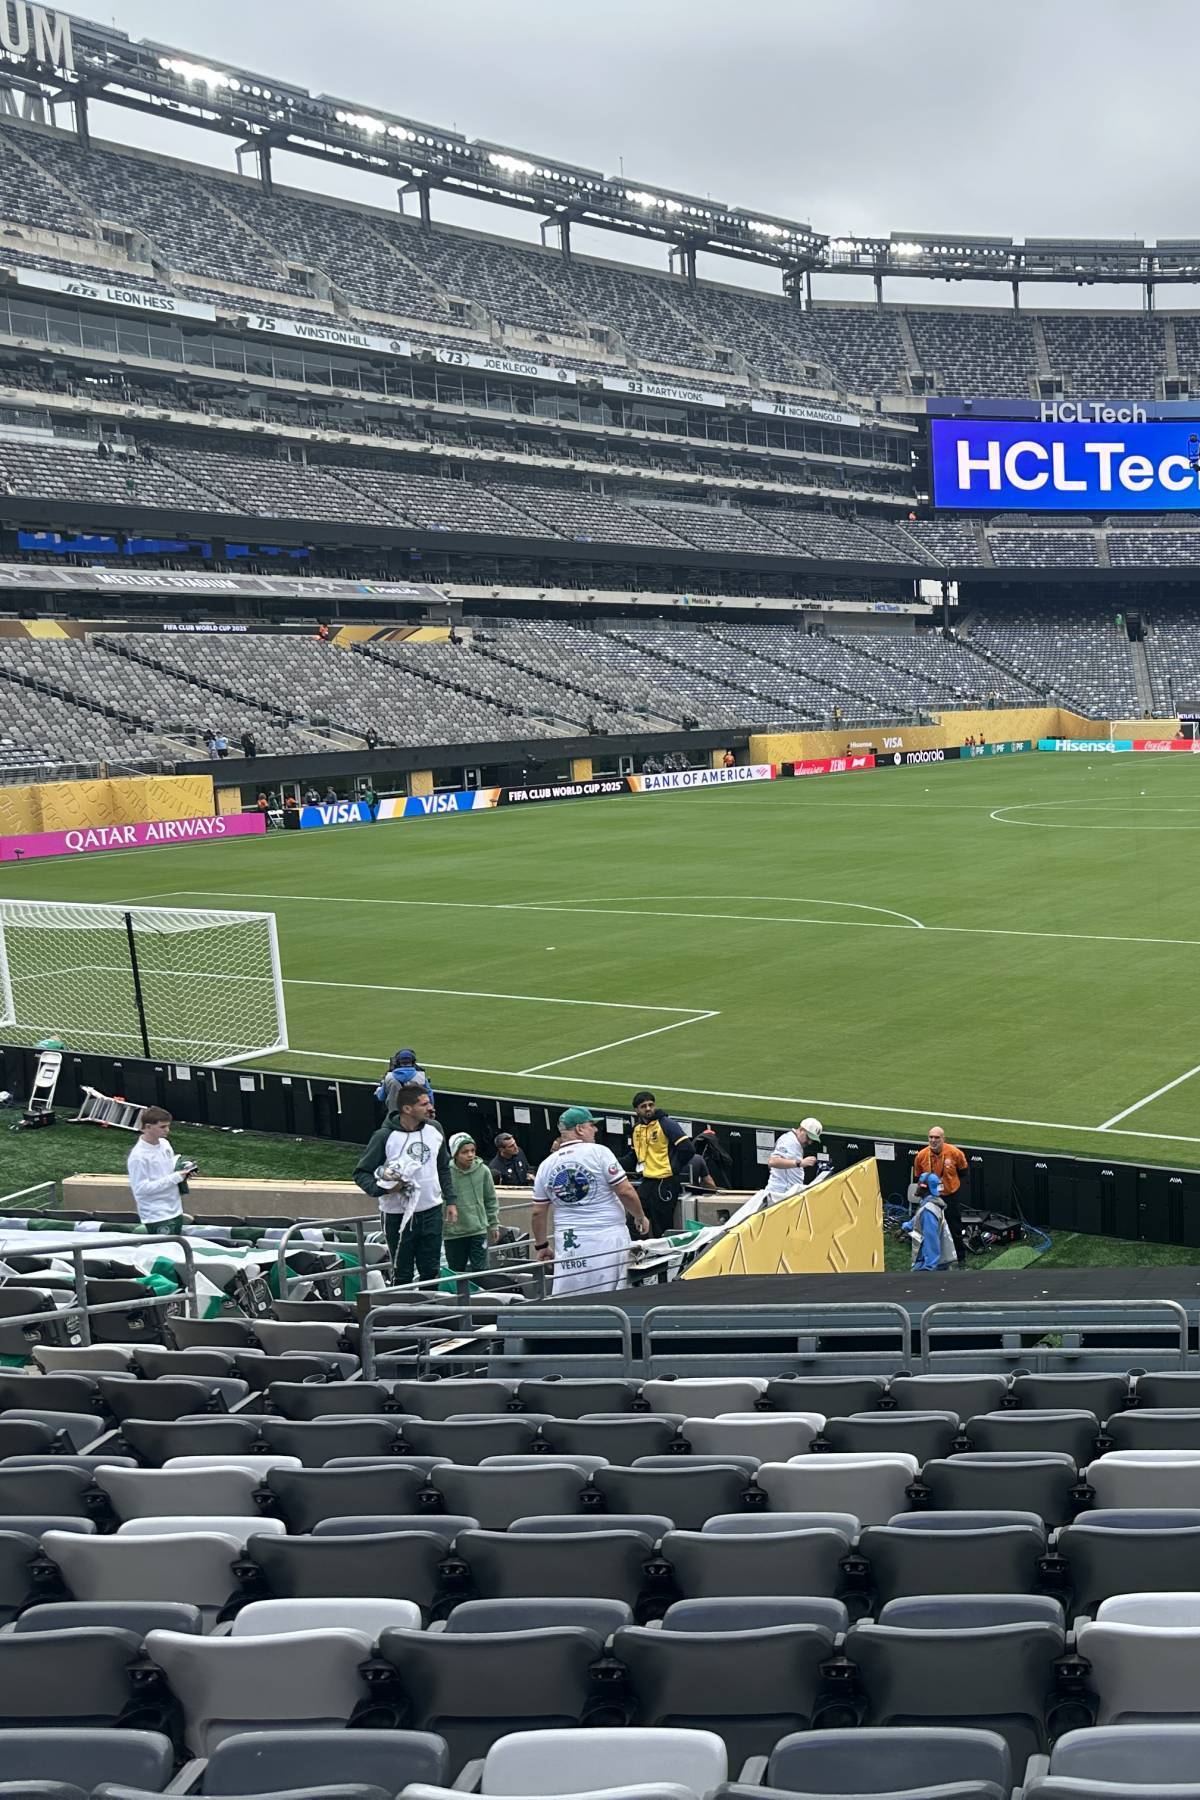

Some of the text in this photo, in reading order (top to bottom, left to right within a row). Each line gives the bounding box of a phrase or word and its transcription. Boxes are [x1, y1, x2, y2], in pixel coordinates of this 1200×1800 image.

[106, 288, 141, 305] LEON
[144, 298, 175, 311] HESS
[256, 316, 370, 347] 75 WINSTON HILL
[484, 359, 538, 376] JOE KLECKO
[628, 381, 703, 402] 93 MARTY LYONS
[772, 404, 786, 415] 74
[788, 408, 806, 417] NICK
[1040, 402, 1147, 423] HCLTech
[96, 573, 239, 589] METLIFE STADIUM
[883, 738, 902, 748] VISA
[1056, 740, 1114, 751] Hisense
[907, 749, 944, 763] motorola
[795, 758, 846, 775] udweiser ZERO
[645, 769, 753, 788] BANK OF AMERICA
[509, 790, 526, 801] FIFA
[528, 788, 550, 799] CLUB
[552, 786, 582, 796] WORLD
[583, 784, 600, 793] CUP
[419, 793, 459, 813] VISA
[320, 803, 361, 824] VISA
[65, 816, 226, 852] QATAR AIRWAYS
[560, 1260, 587, 1269] VERDE
